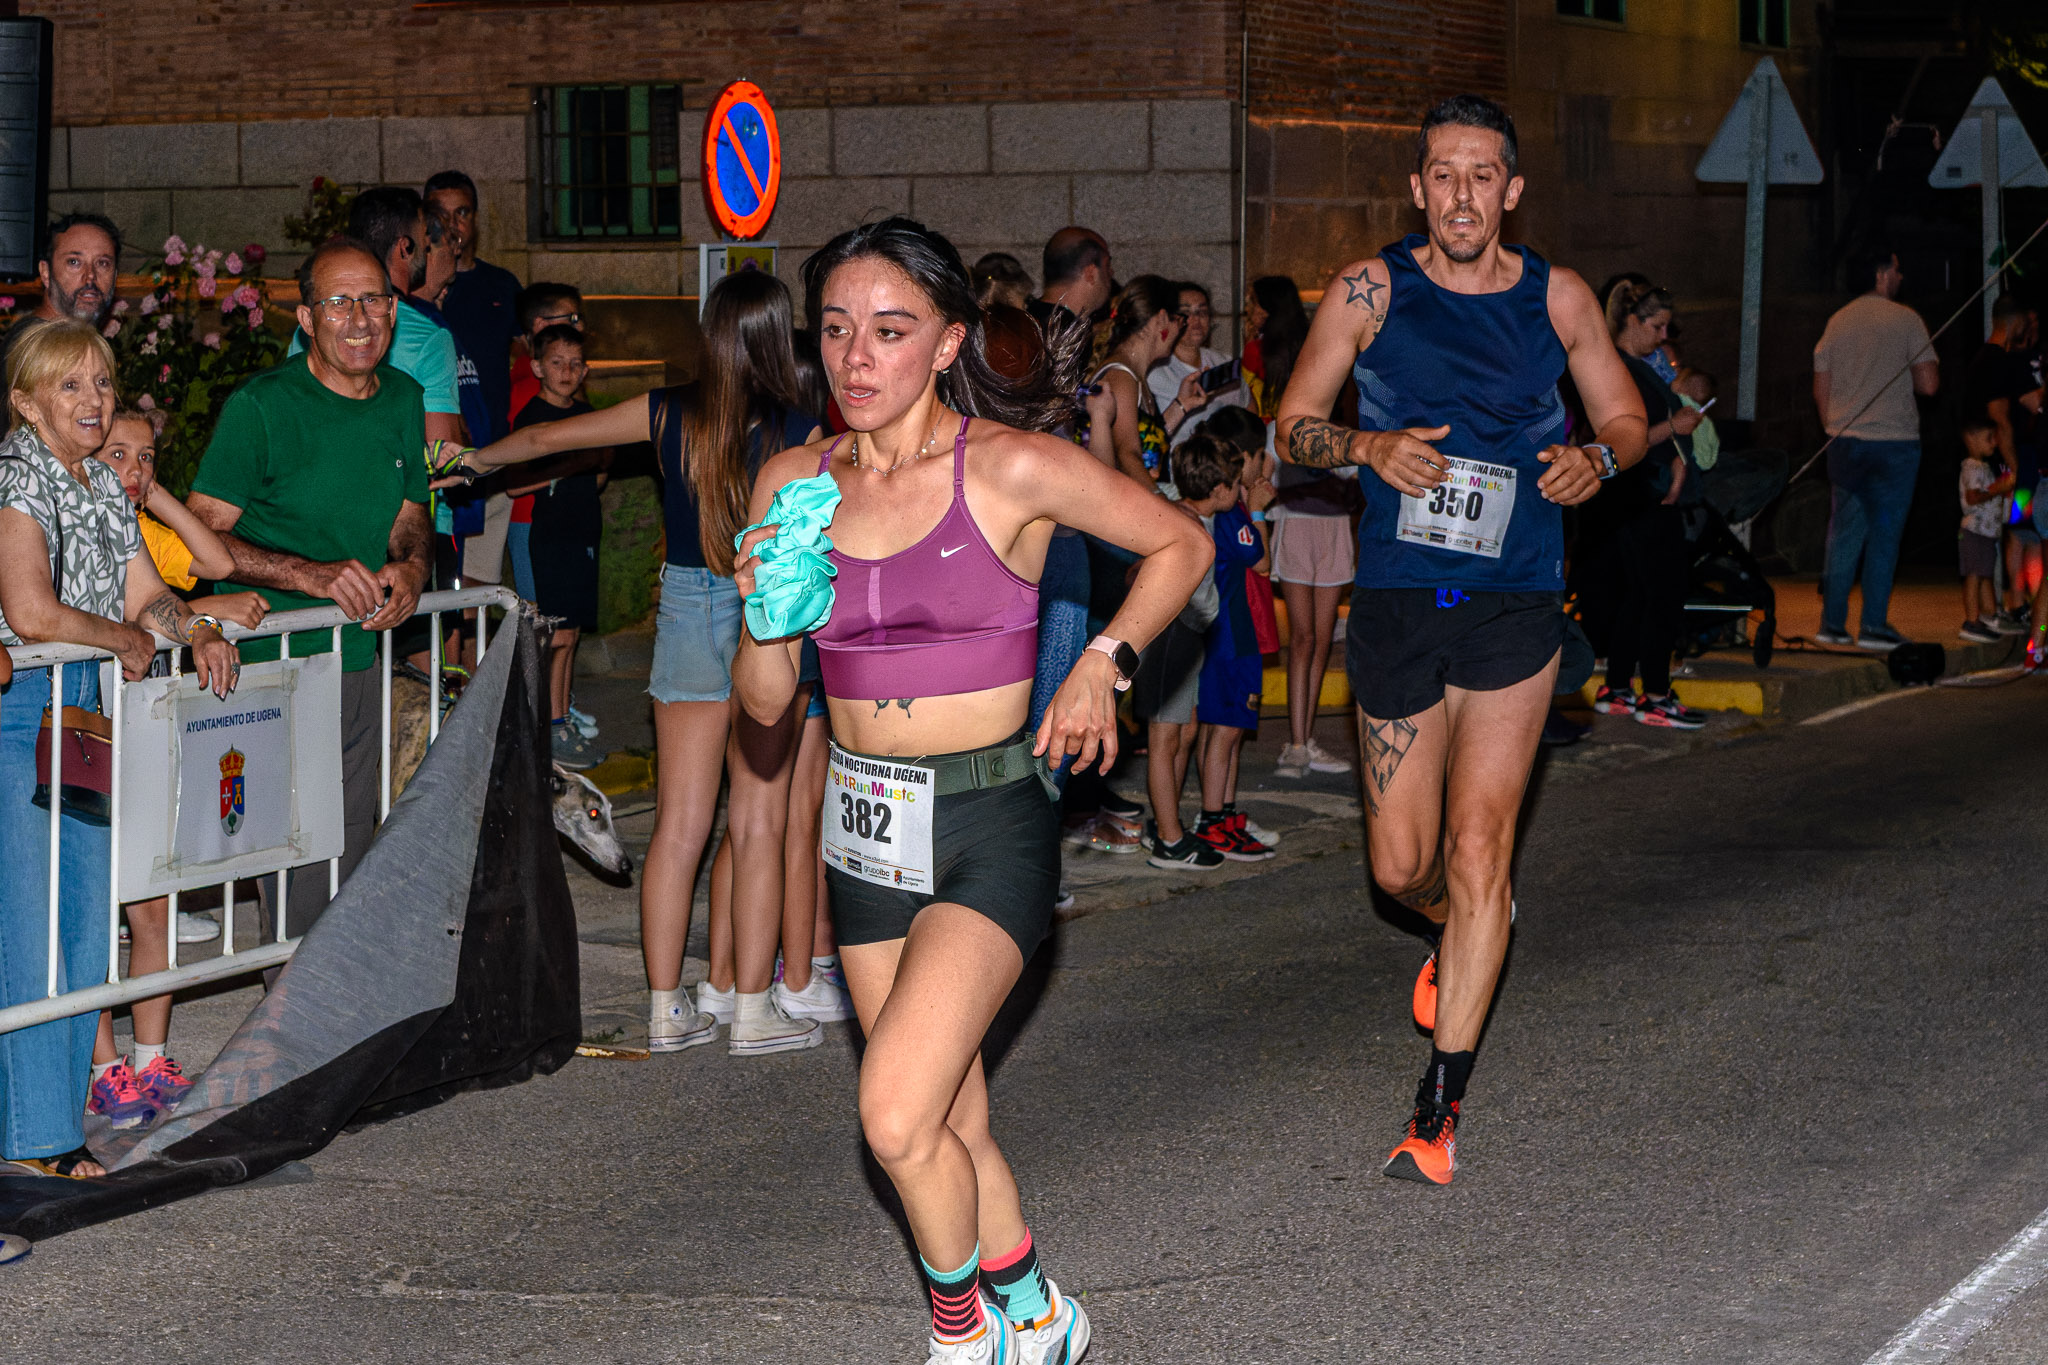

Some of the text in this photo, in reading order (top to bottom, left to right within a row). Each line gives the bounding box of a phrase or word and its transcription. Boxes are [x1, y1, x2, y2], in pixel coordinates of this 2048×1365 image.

[1428, 484, 1484, 522] 350
[186, 707, 282, 734] AYUNTAMIENTO DE UGENA
[844, 756, 892, 780] NOCTURNA
[893, 767, 928, 785] UGENA
[840, 791, 892, 845] 382
